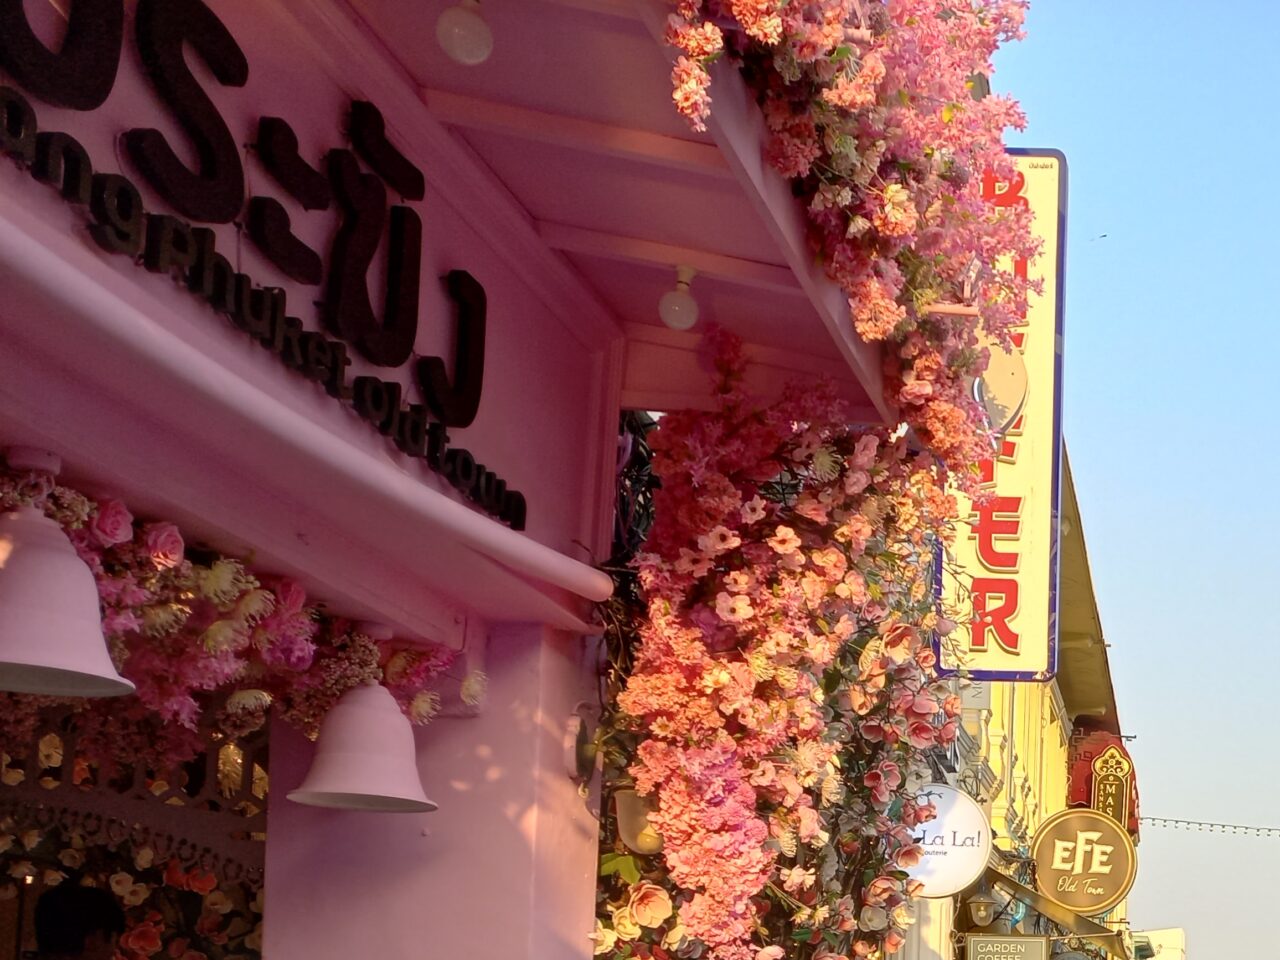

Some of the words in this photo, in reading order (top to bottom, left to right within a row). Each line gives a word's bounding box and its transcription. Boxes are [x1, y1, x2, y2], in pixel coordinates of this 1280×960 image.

[951, 830, 981, 847] La!
[1051, 830, 1114, 875] EFE
[1057, 875, 1079, 892] Old
[1082, 877, 1105, 895] Town
[977, 943, 1026, 953] GARDEN
